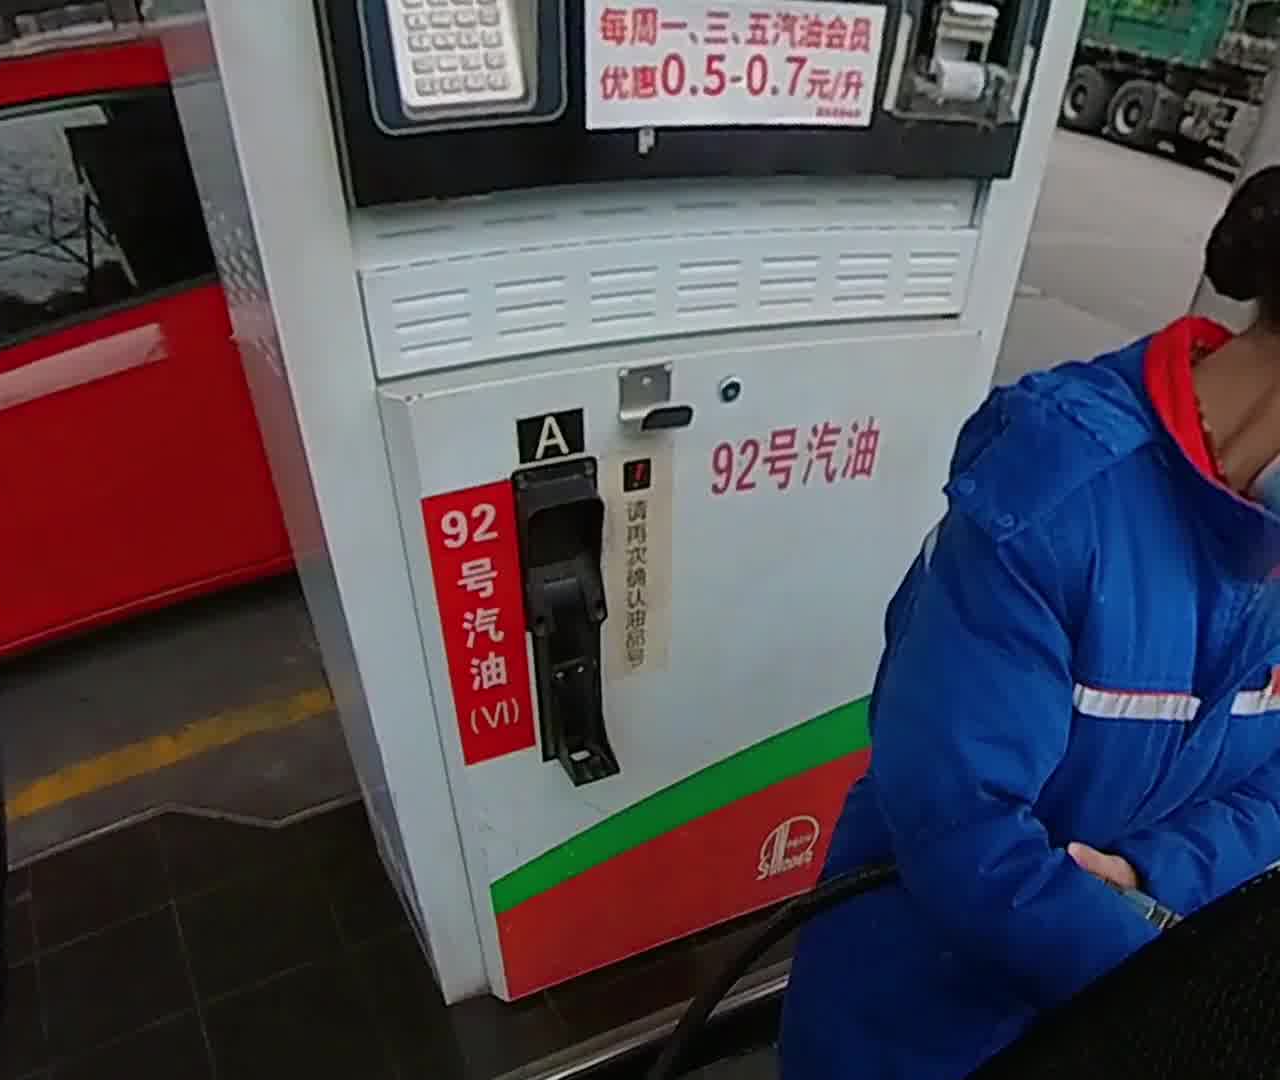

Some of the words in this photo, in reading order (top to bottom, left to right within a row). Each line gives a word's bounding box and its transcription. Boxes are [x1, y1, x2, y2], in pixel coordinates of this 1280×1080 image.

[600, 7, 872, 52] 每周一、三、五汽油会员
[600, 53, 864, 99] 优惠0.5-0.7元/升
[534, 415, 571, 459] A
[712, 417, 881, 496] 92号汽油
